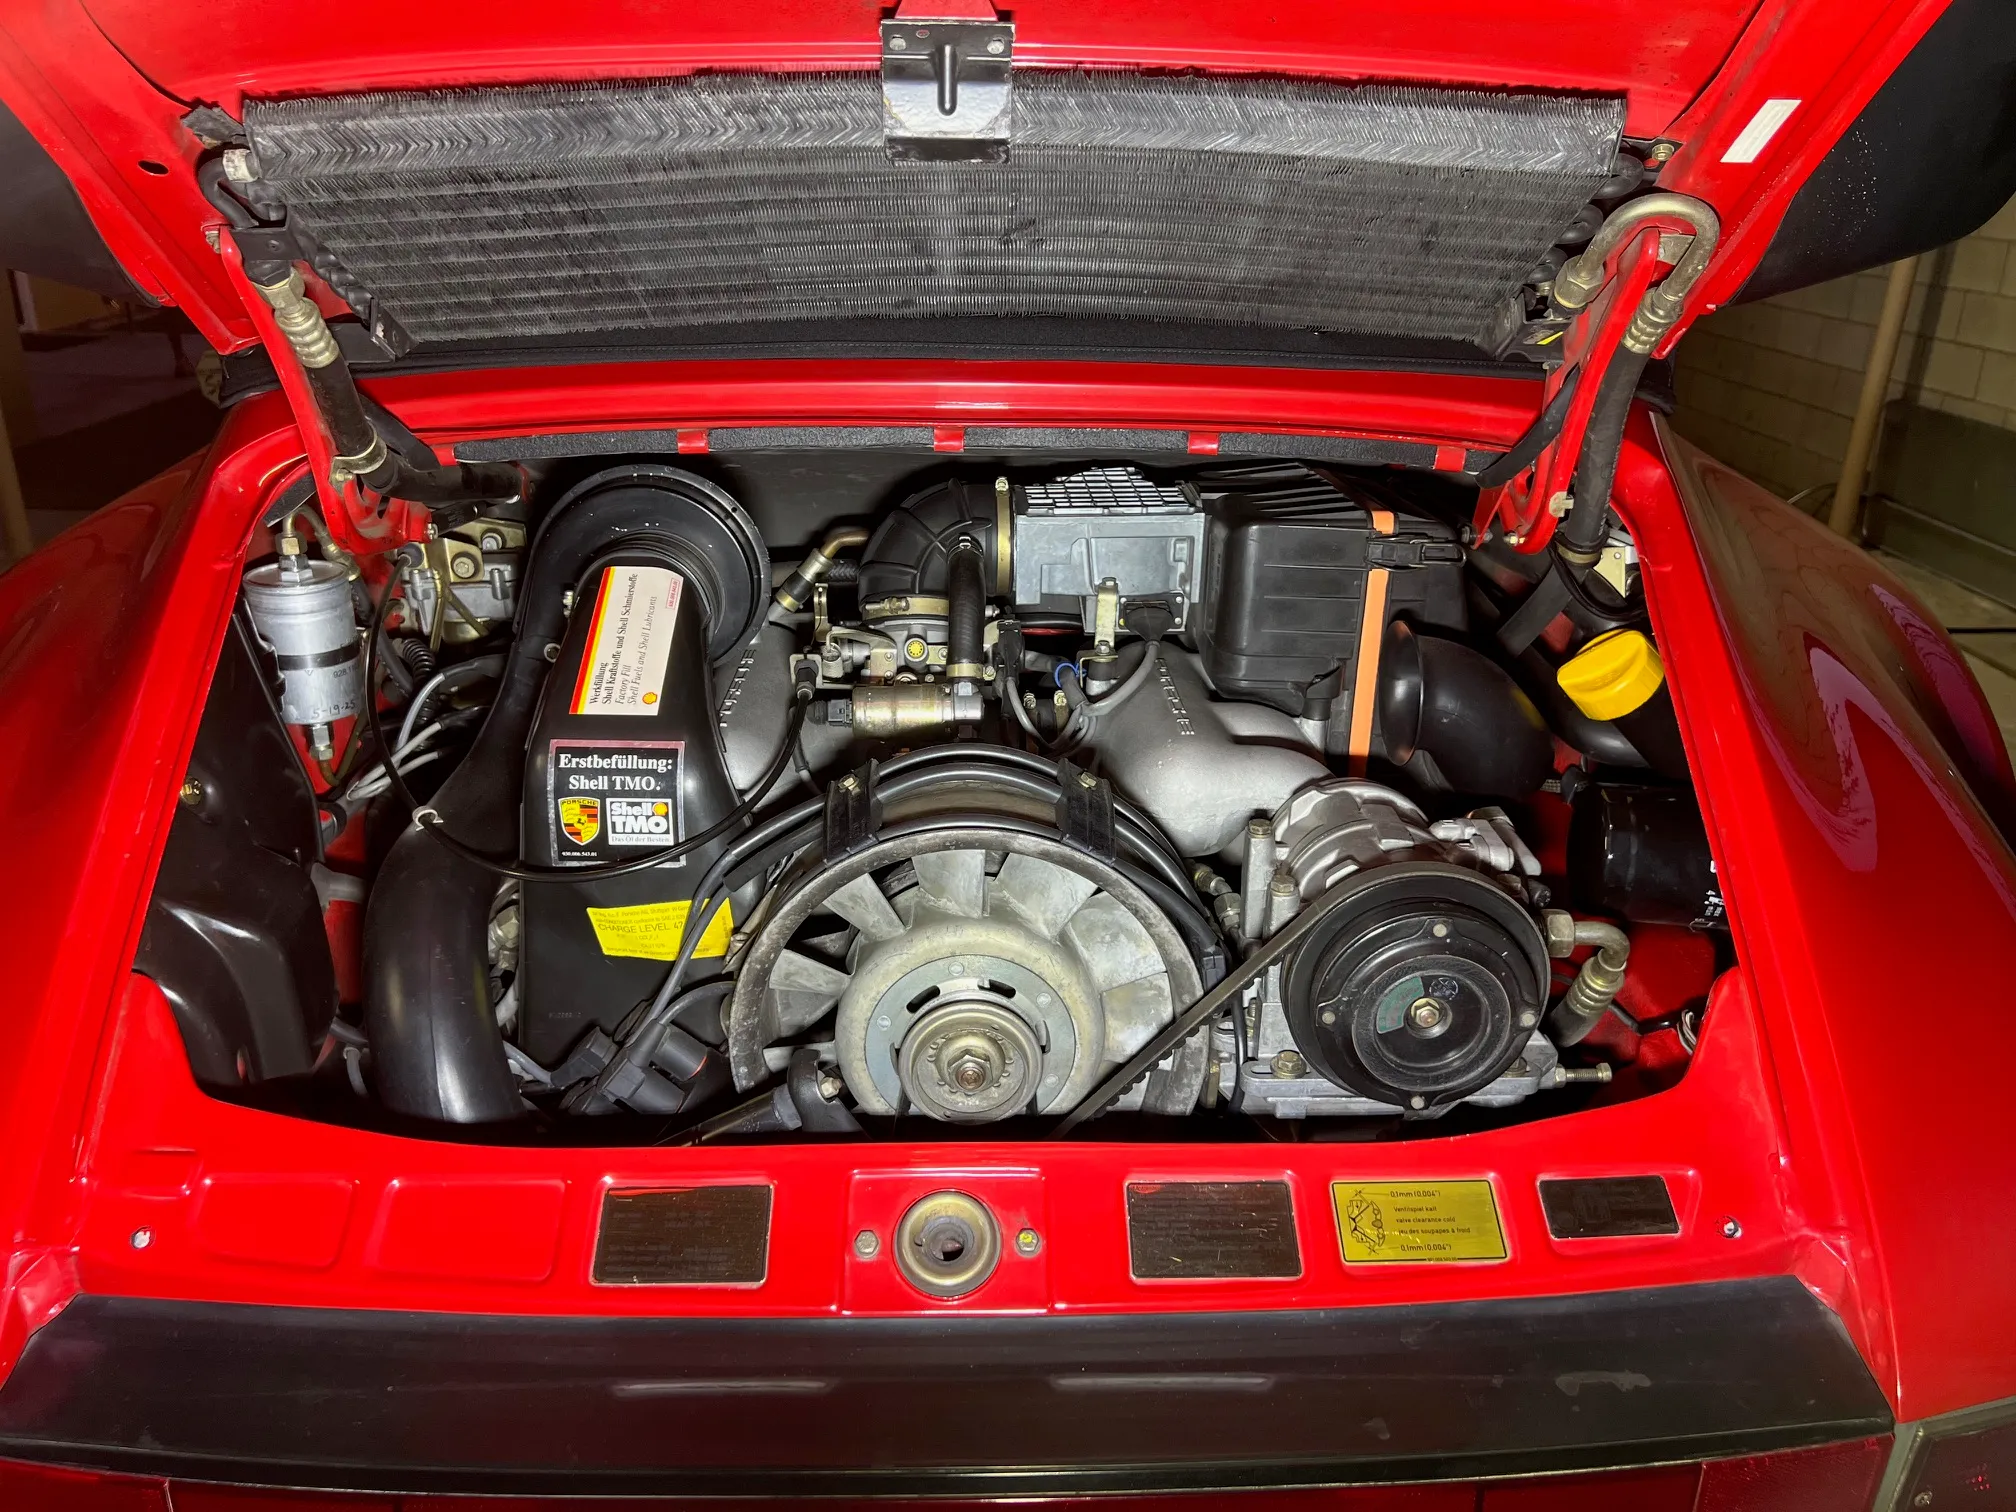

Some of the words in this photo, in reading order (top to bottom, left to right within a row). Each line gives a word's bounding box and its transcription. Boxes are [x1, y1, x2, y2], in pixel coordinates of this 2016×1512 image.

[621, 573, 638, 615] Schmierstoffe
[642, 596, 658, 632] Lubricants
[617, 617, 629, 634] Shell
[616, 636, 625, 649] und
[638, 632, 651, 650] Shell
[637, 650, 646, 665] and
[606, 650, 622, 684] Kraftstoffe
[621, 664, 632, 677] Fill
[631, 666, 644, 685] Fuels
[589, 662, 609, 704] Werkfüllung
[615, 678, 631, 704] Factory
[602, 686, 614, 704] Shell
[627, 685, 639, 704] Shell
[559, 753, 672, 773] Erstbefüllung:
[569, 775, 608, 791] Shell
[612, 776, 661, 791] TMO.
[611, 801, 652, 816] Shell
[611, 815, 668, 833] TMO
[611, 835, 624, 843] Das
[625, 834, 634, 843] Öl
[635, 835, 646, 843] der
[647, 836, 671, 844] Besten.
[597, 923, 636, 933] CHARGE
[639, 922, 670, 933] LEVEL
